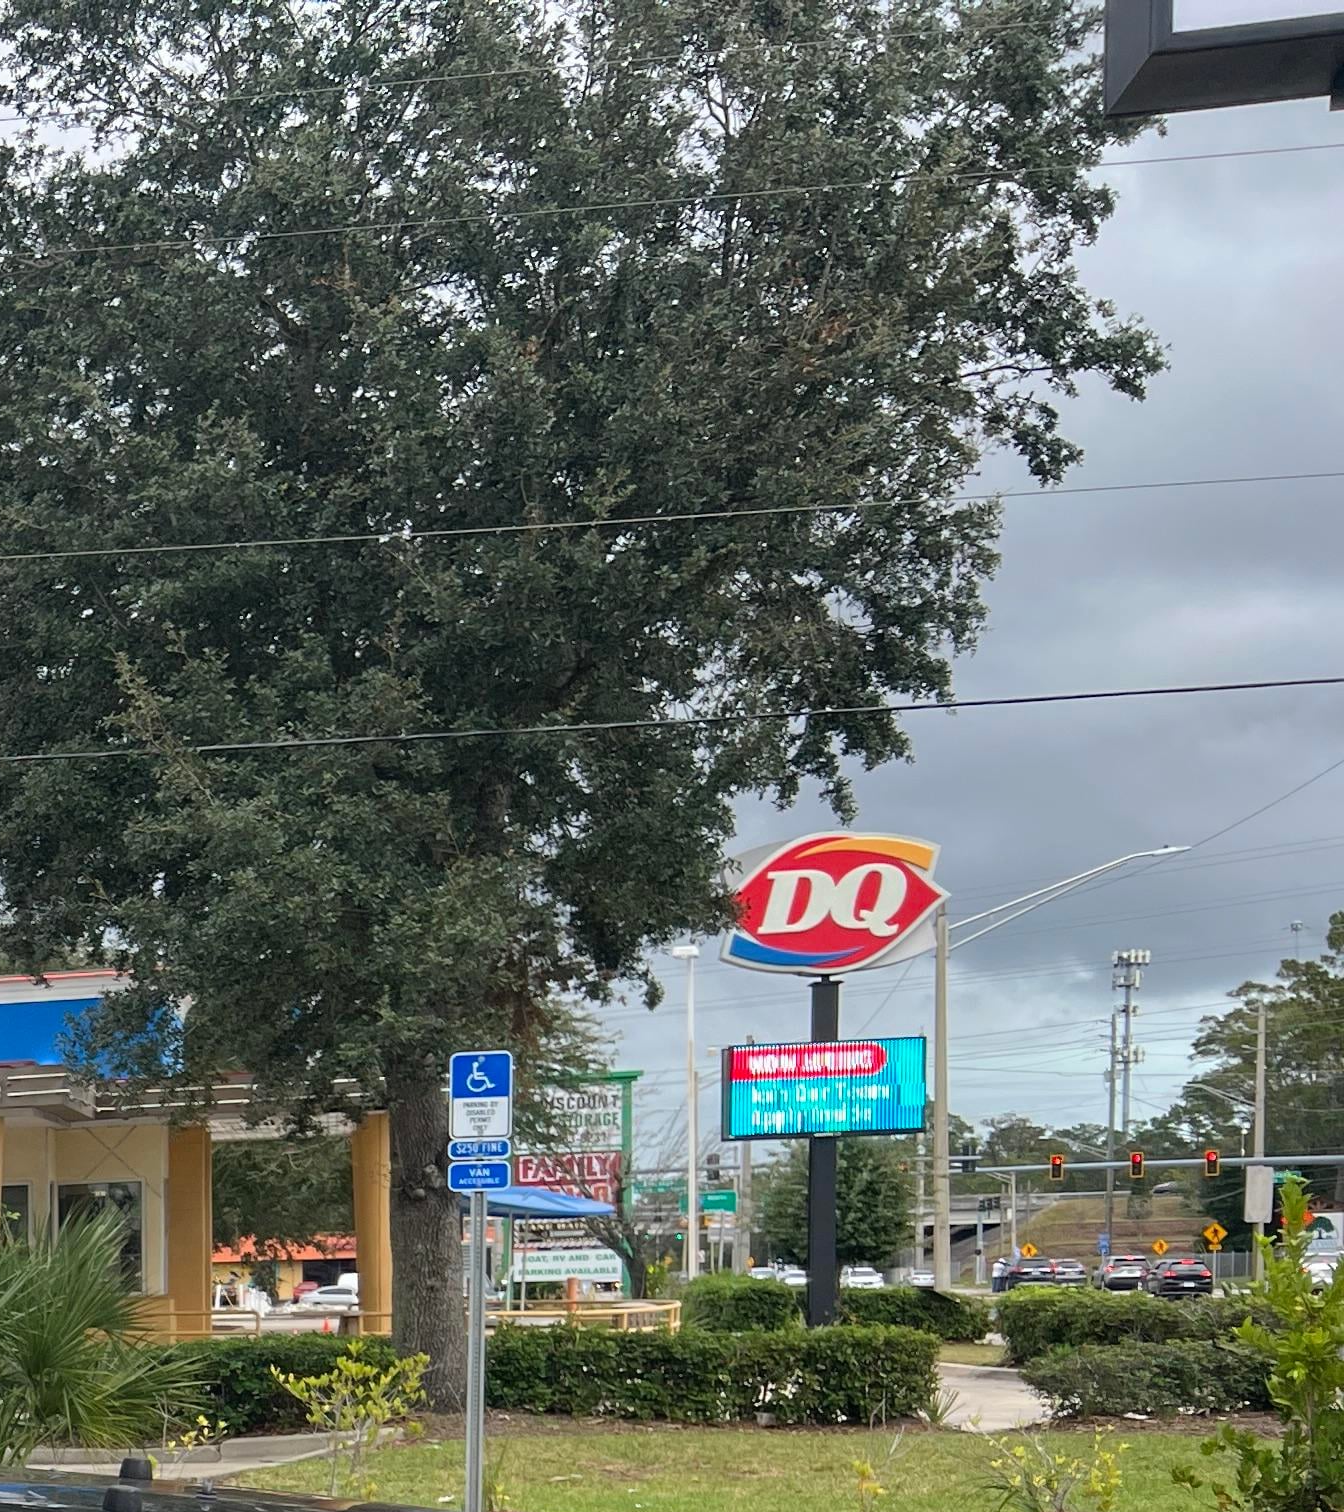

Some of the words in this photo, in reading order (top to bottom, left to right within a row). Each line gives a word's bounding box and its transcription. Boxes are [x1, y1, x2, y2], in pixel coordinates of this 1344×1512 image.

[757, 863, 907, 937] DQ
[456, 1142, 479, 1154] $250
[481, 1142, 503, 1153] FINE
[469, 1168, 490, 1177] VAN
[459, 1177, 500, 1185] ACCESSIBLE
[564, 1266, 619, 1275] AVAILABLE
